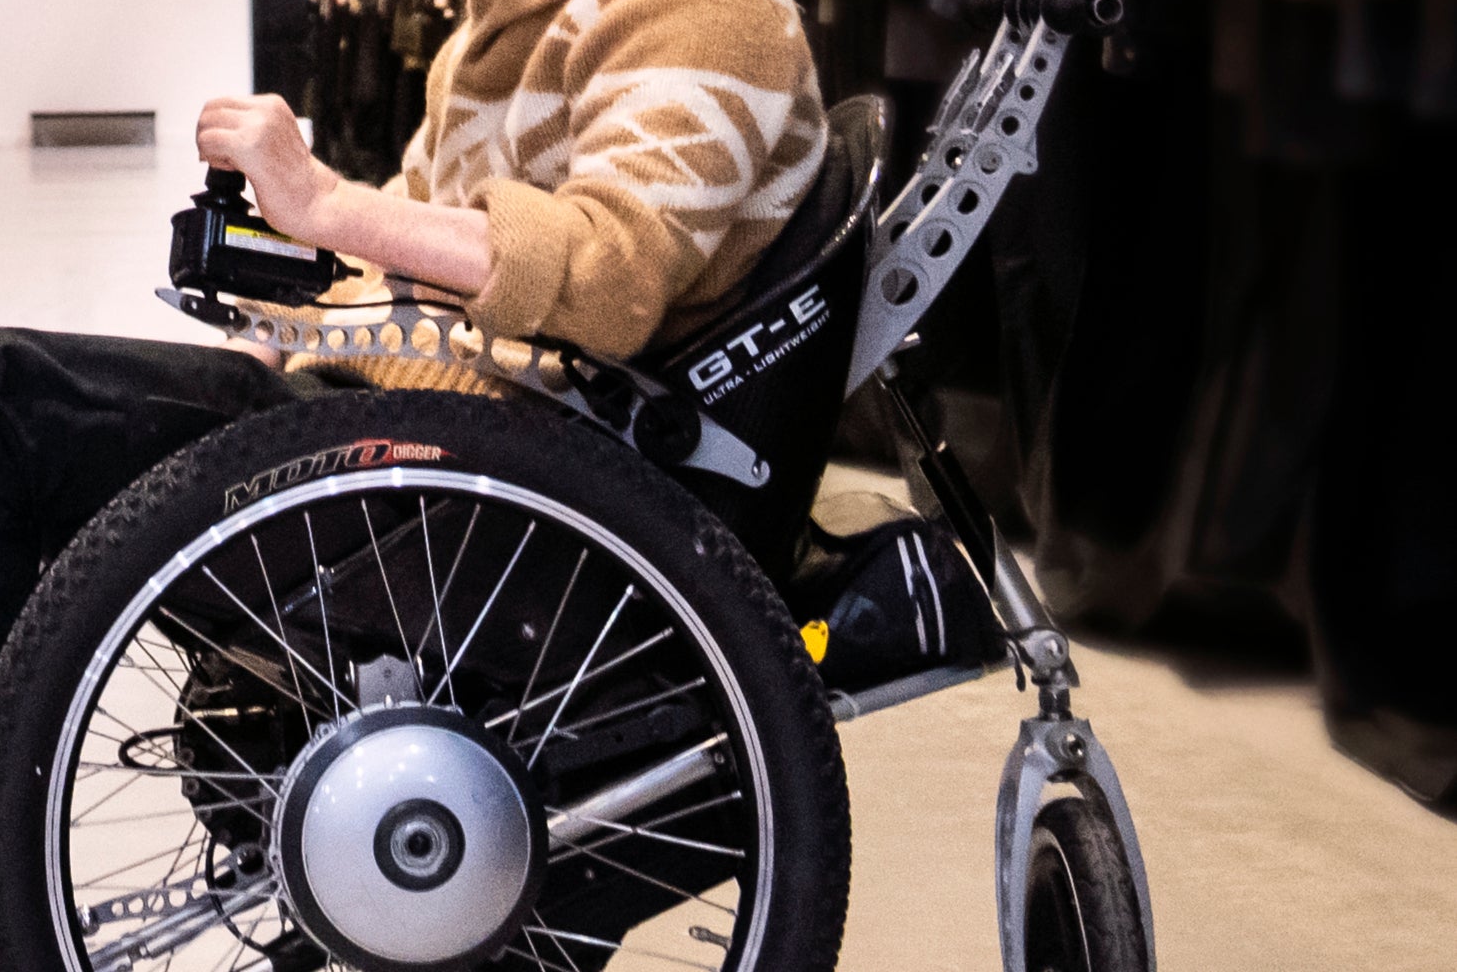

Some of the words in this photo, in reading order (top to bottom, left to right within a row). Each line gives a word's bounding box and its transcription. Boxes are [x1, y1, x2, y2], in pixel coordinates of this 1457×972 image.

[688, 284, 826, 391] GT-E
[703, 375, 744, 405] ULTRA
[753, 309, 831, 373] LIGHTWEIGHT
[224, 443, 391, 515] MOTO
[393, 445, 442, 461] DIGGER
